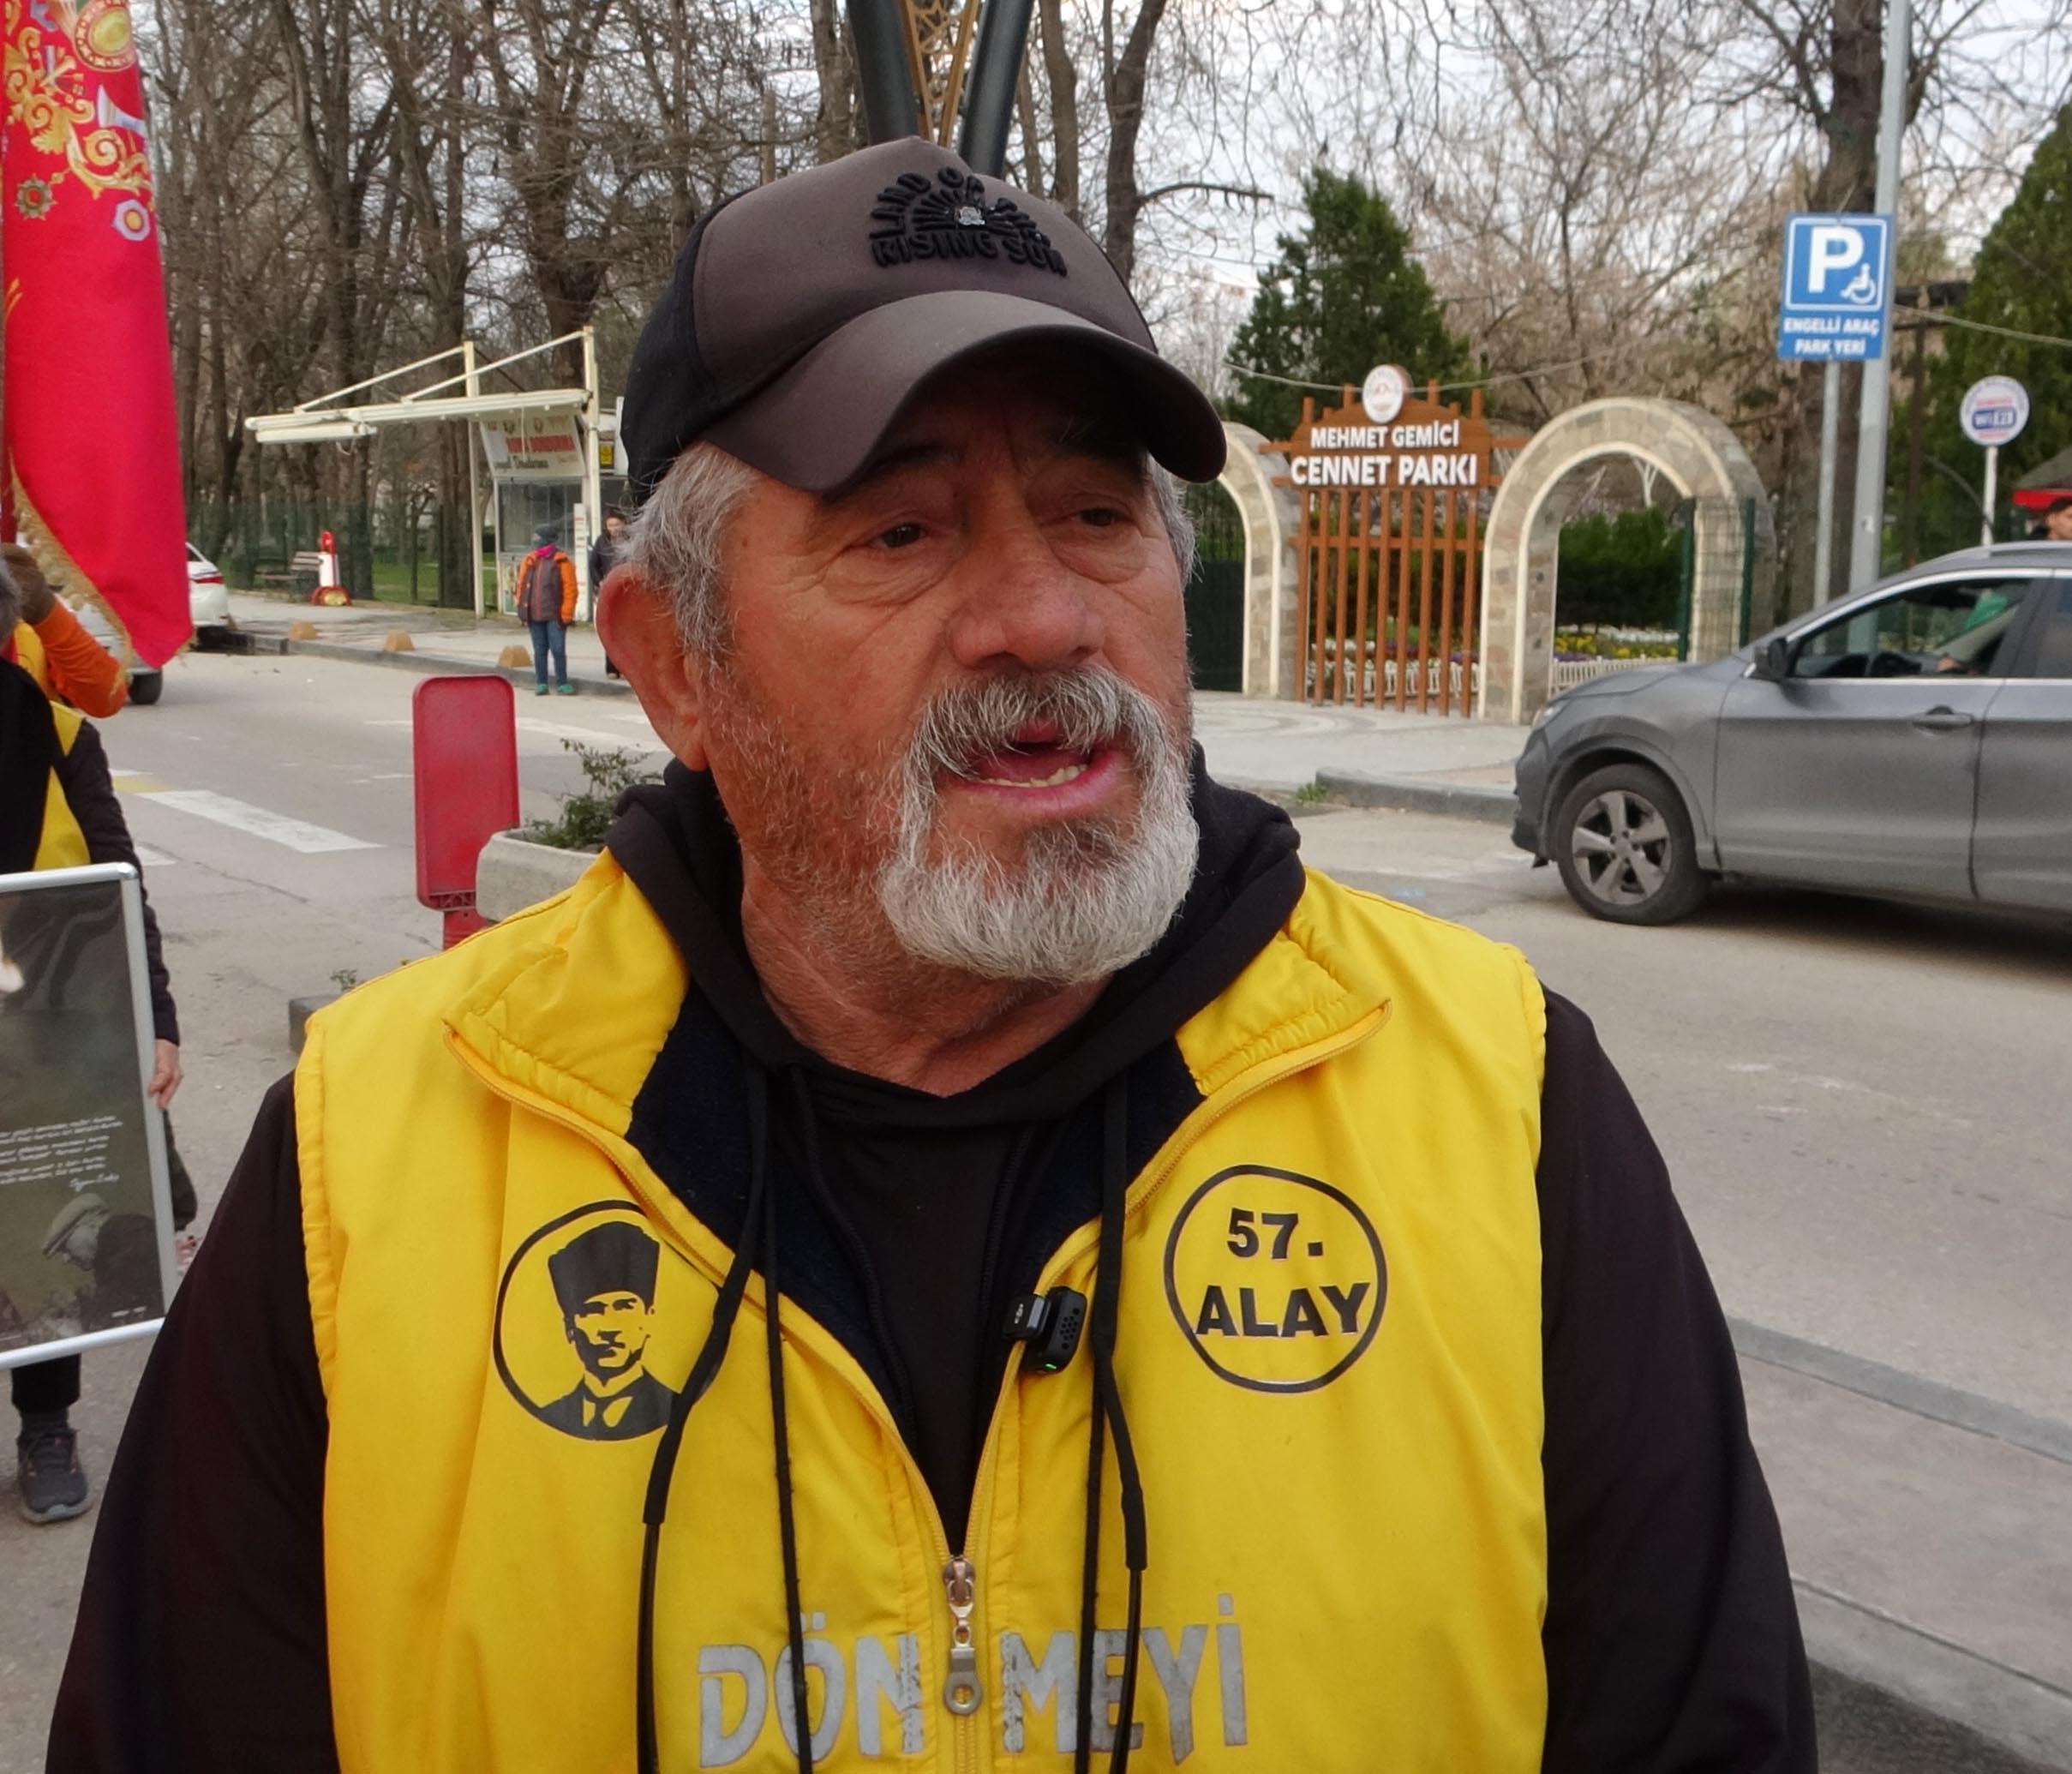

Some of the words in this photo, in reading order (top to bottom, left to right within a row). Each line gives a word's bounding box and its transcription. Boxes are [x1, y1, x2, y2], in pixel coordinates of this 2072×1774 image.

[871, 231, 998, 268] RISING
[1002, 236, 1068, 278] SUN
[1808, 225, 1864, 293] P
[1783, 316, 1841, 333] ENGELLİ
[1843, 318, 1880, 337] ARAÇ
[1794, 338, 1831, 355] PARK
[1833, 338, 1866, 356] YERİ
[1311, 427, 1387, 449] MEHMET
[1392, 420, 1459, 447] GEMİCİ
[1291, 455, 1392, 486] CENNET
[1398, 453, 1477, 486] PARKI
[1227, 1208, 1324, 1260] 57.
[1196, 1282, 1371, 1338] ALAY
